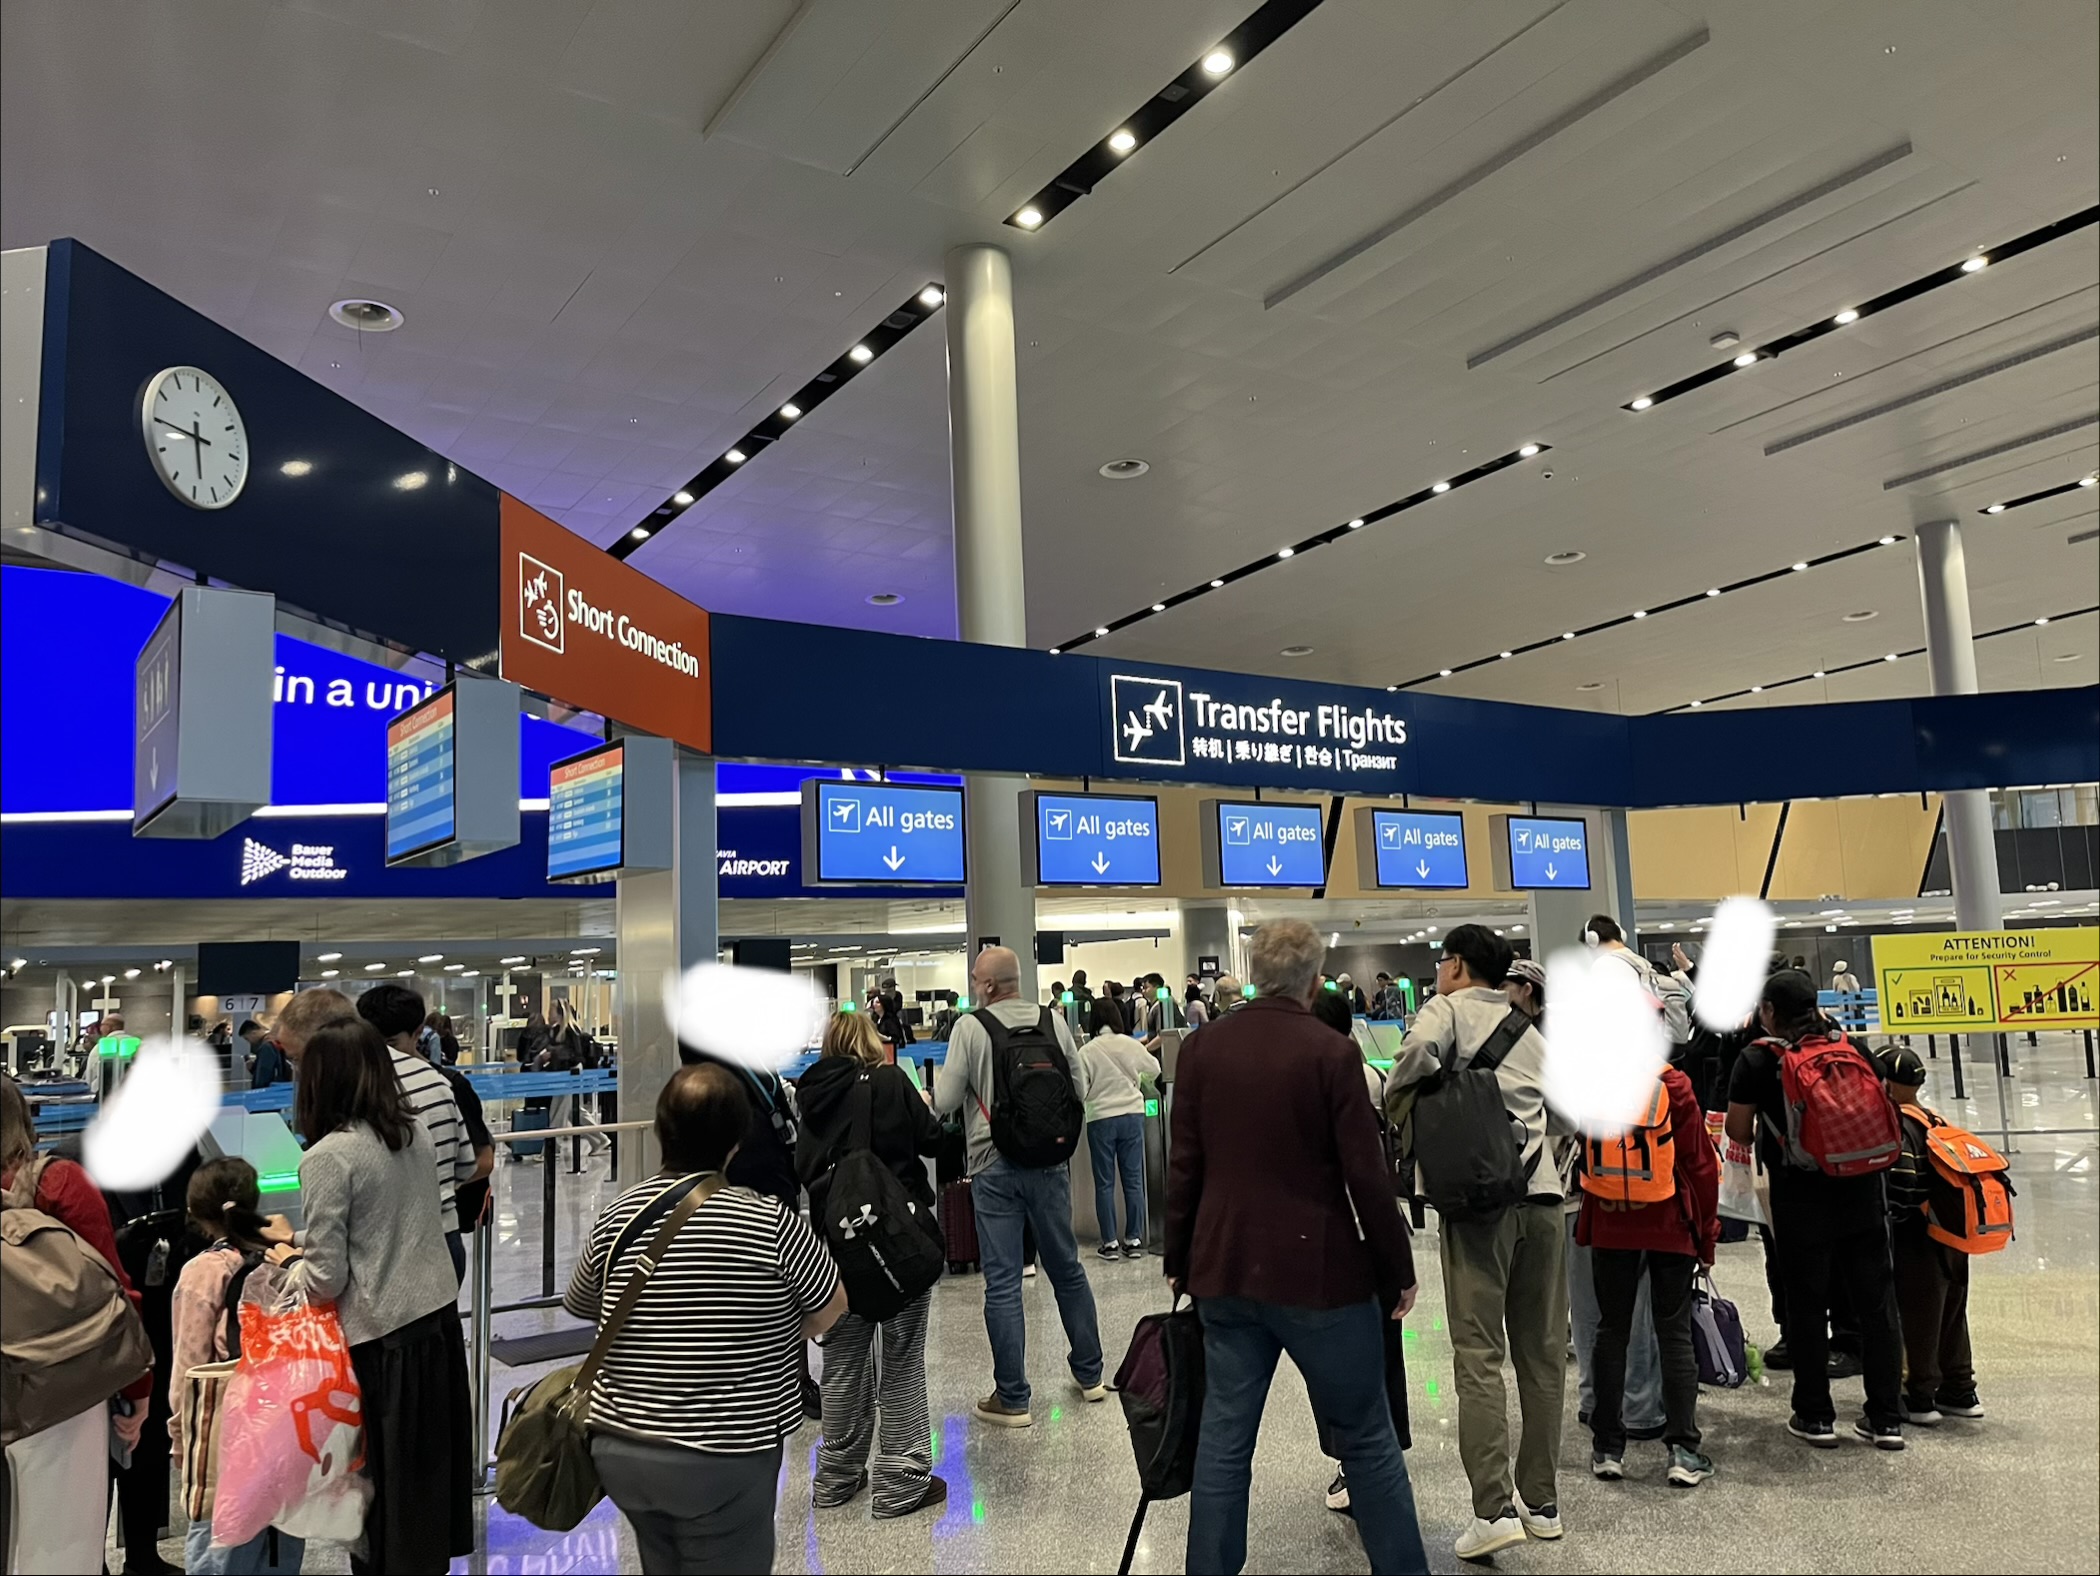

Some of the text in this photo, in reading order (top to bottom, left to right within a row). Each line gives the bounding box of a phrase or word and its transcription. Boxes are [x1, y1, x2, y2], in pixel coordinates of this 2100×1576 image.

[568, 588, 699, 678] Short Connection
[273, 666, 314, 704] in
[326, 679, 355, 707] a
[1189, 692, 1408, 749] Transfer Flights
[1342, 749, 1397, 771] Транзит
[865, 805, 955, 834] All gates
[1076, 815, 1150, 840] All gates
[1253, 821, 1317, 845] All gates
[1403, 828, 1459, 849] All gates
[1534, 833, 1582, 853] All gates
[291, 843, 334, 856] Bauer
[716, 850, 737, 859] AVIA
[290, 855, 334, 867] Media
[719, 860, 790, 876] AIRPORT
[289, 867, 347, 879] Outdoor
[1943, 935, 2036, 951] ATTENTION!
[1930, 949, 2052, 962] Prepare for Security Control
[225, 997, 259, 1010] 6 7
